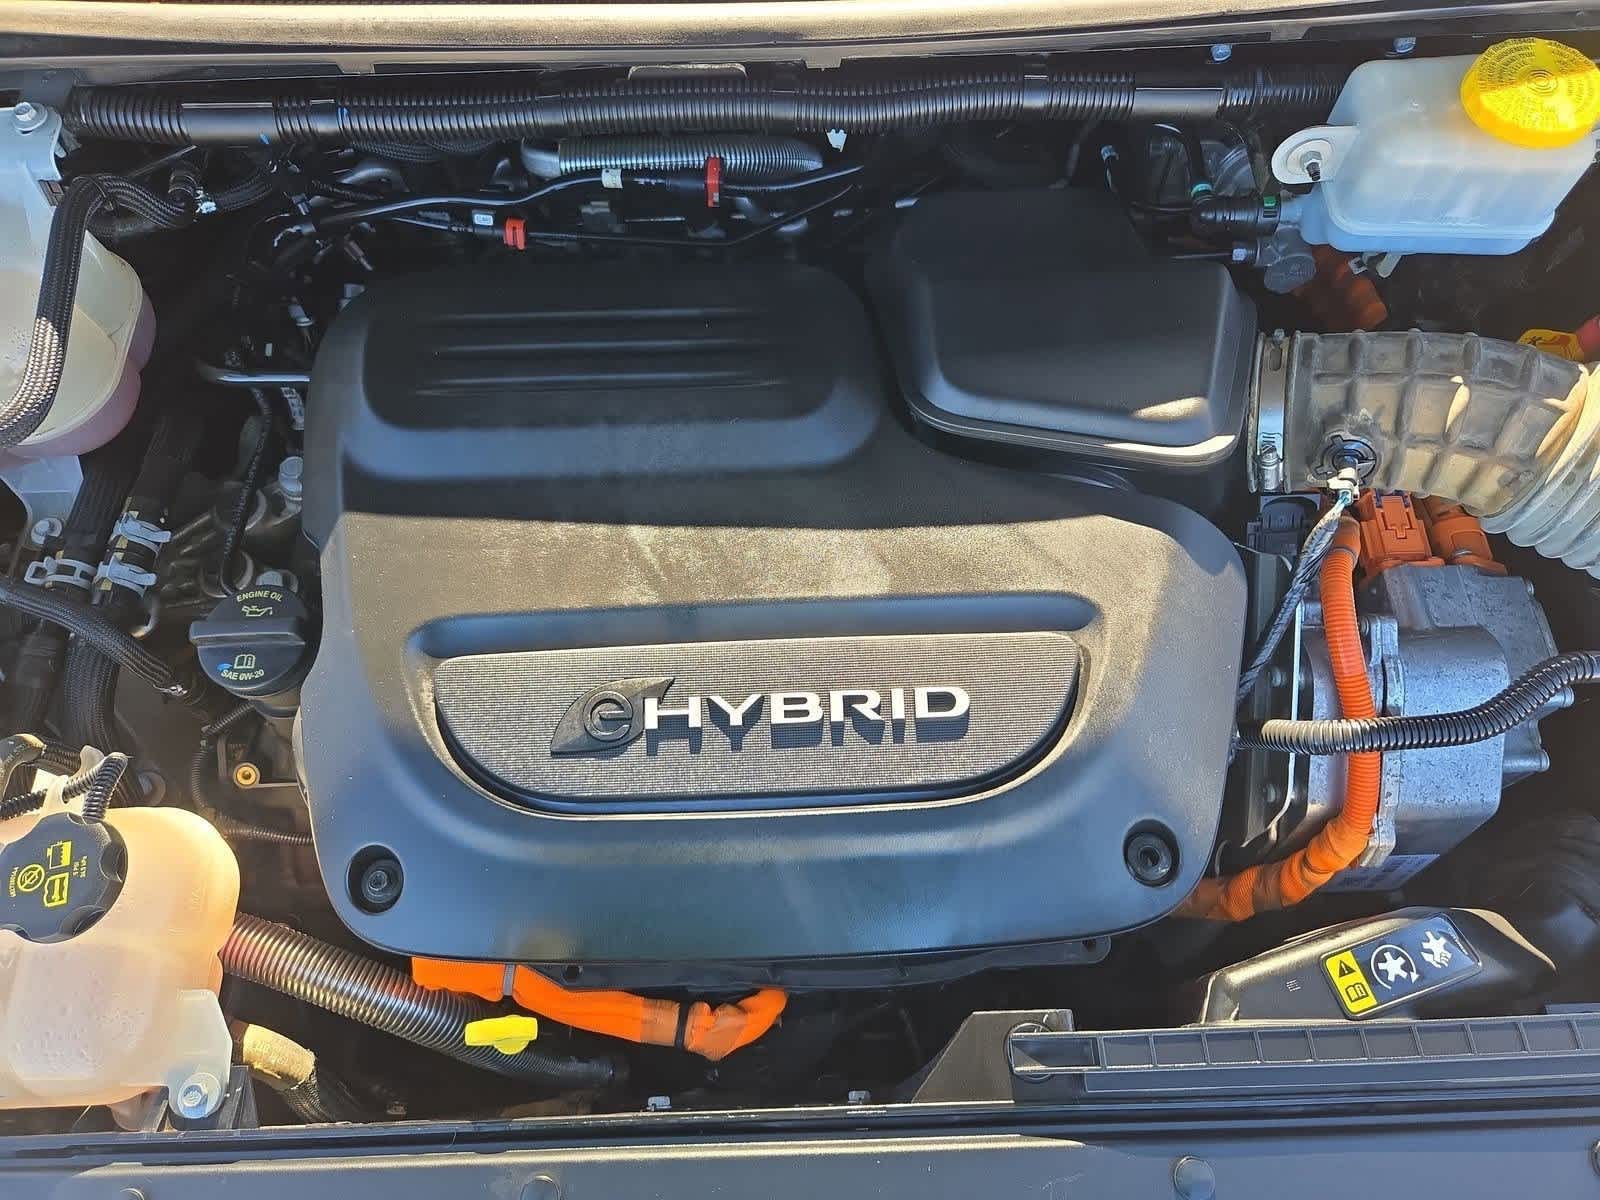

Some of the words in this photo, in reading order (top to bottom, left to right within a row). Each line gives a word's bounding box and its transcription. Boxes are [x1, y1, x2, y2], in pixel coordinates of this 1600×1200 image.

[236, 590, 269, 603] ENGINE
[270, 591, 283, 602] OIL
[221, 669, 238, 681] SAE
[239, 669, 265, 681] 0W-20
